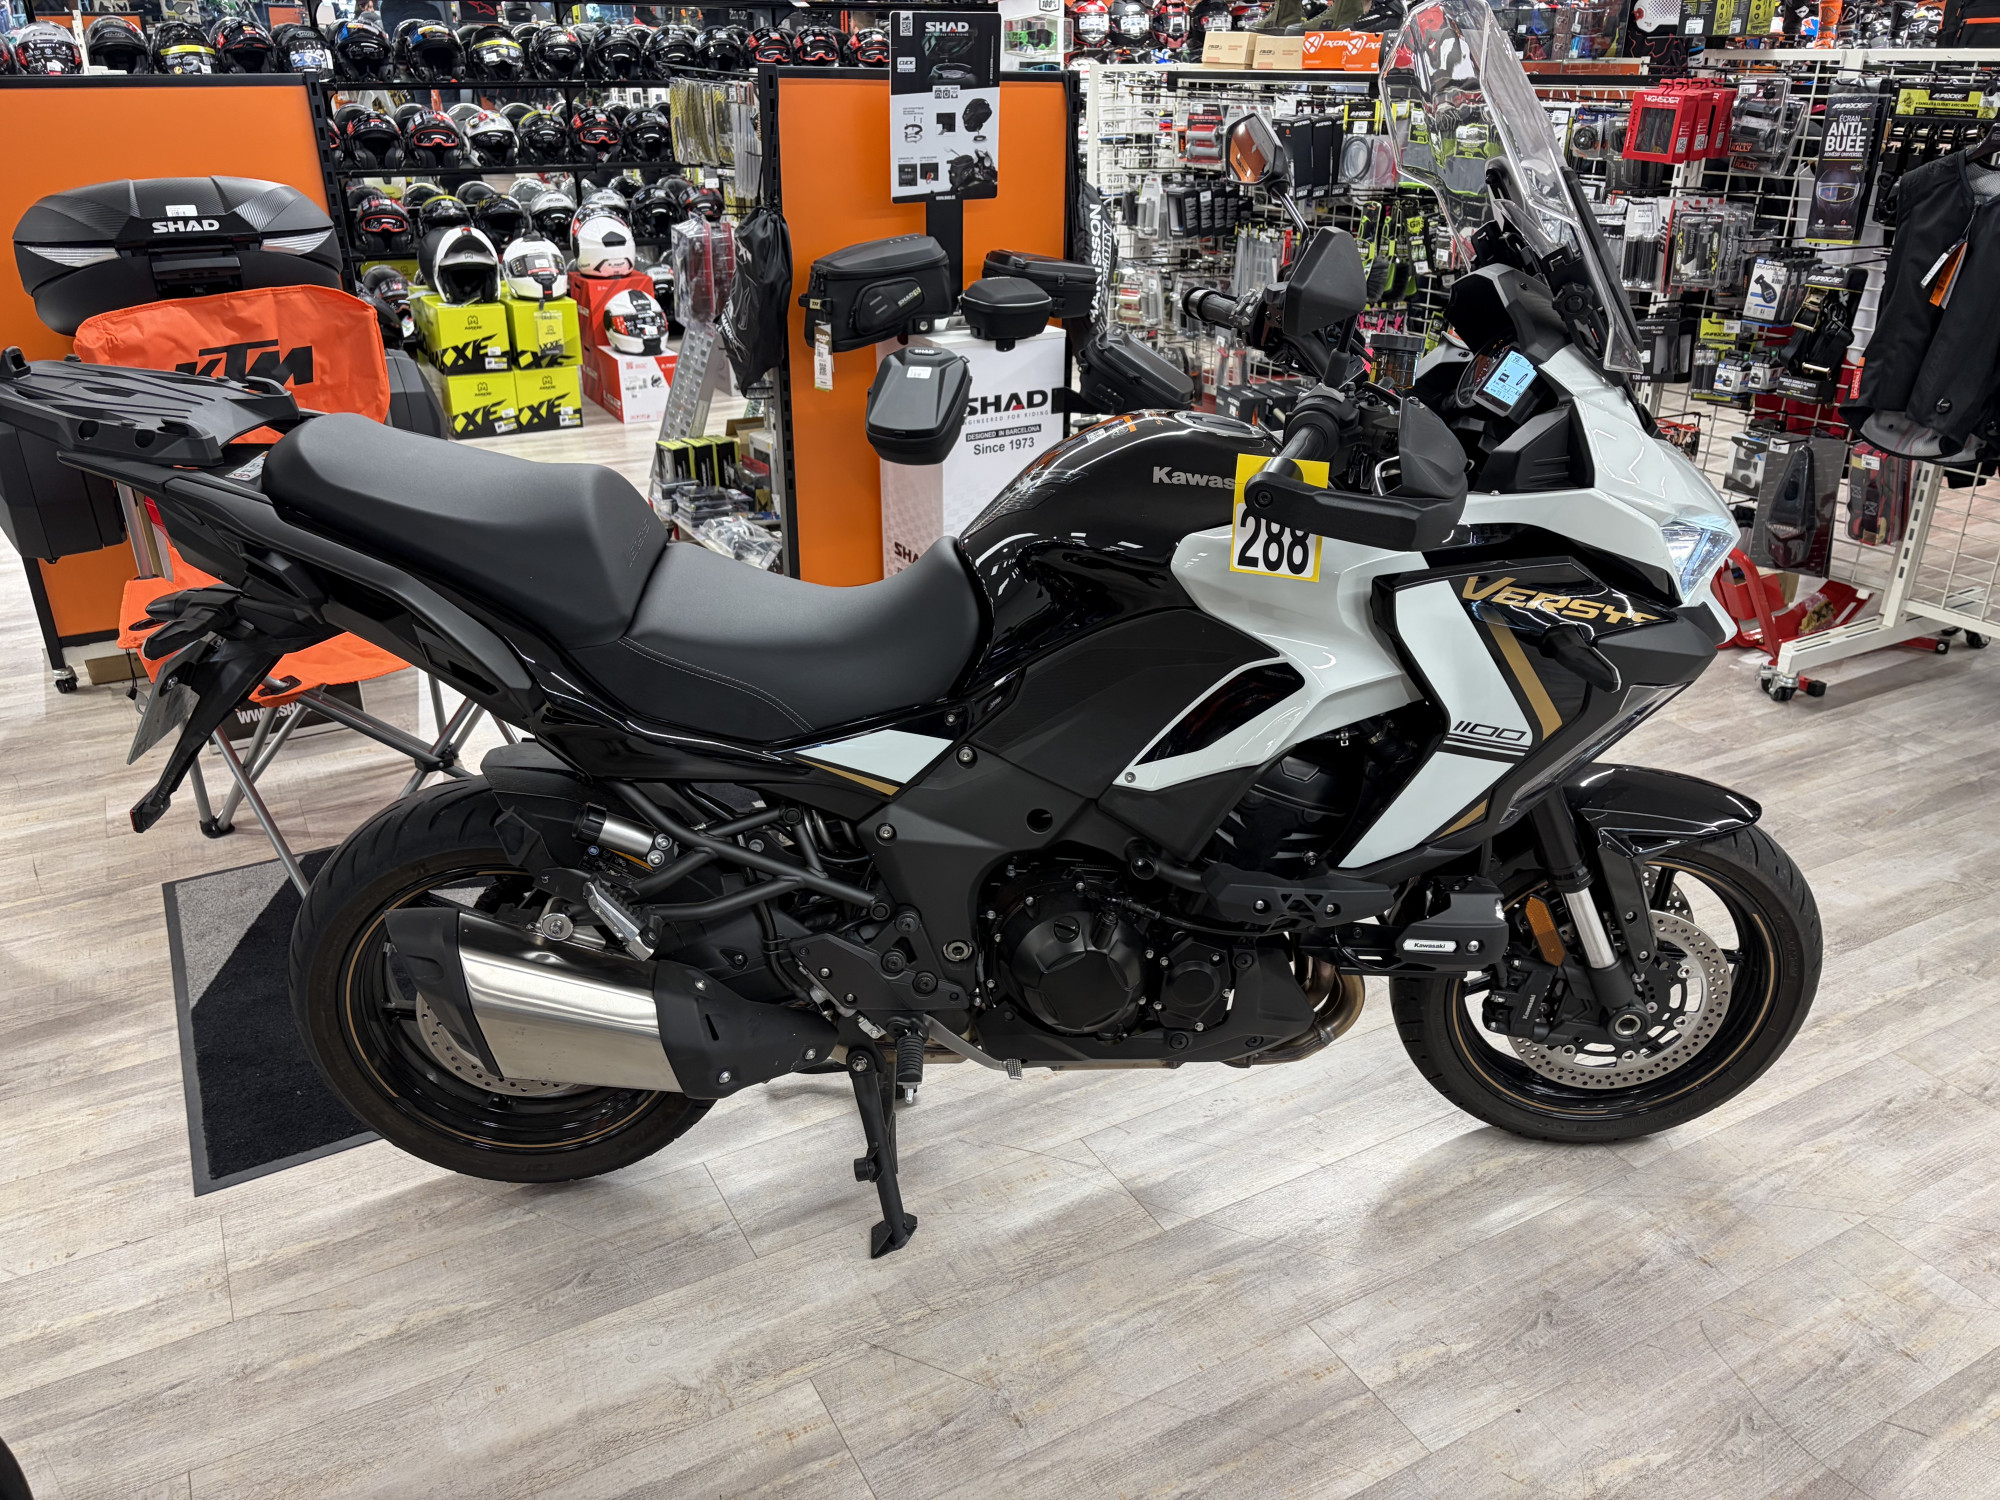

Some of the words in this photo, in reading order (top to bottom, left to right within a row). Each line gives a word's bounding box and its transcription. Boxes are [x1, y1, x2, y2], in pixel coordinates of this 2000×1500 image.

[925, 22, 969, 33] SHAD
[1644, 94, 1681, 104] HIGHSIDER
[1839, 114, 1861, 122] ÉCRAN
[1827, 122, 1868, 136] ANTI-
[1824, 134, 1867, 152] BUÉE
[152, 220, 220, 234] SHAD
[968, 389, 1049, 417] SHAD
[964, 415, 1004, 425] GINEERED
[1024, 410, 1049, 418] RIDING
[967, 430, 997, 441] DESIGNED
[1005, 425, 1040, 436] BARCELONA
[973, 442, 1005, 455] Since
[1009, 437, 1035, 450] 1973
[1152, 466, 1235, 490] Kawas
[1237, 507, 1310, 575] 288
[894, 541, 920, 563] SHA
[1453, 720, 1527, 742] 1100
